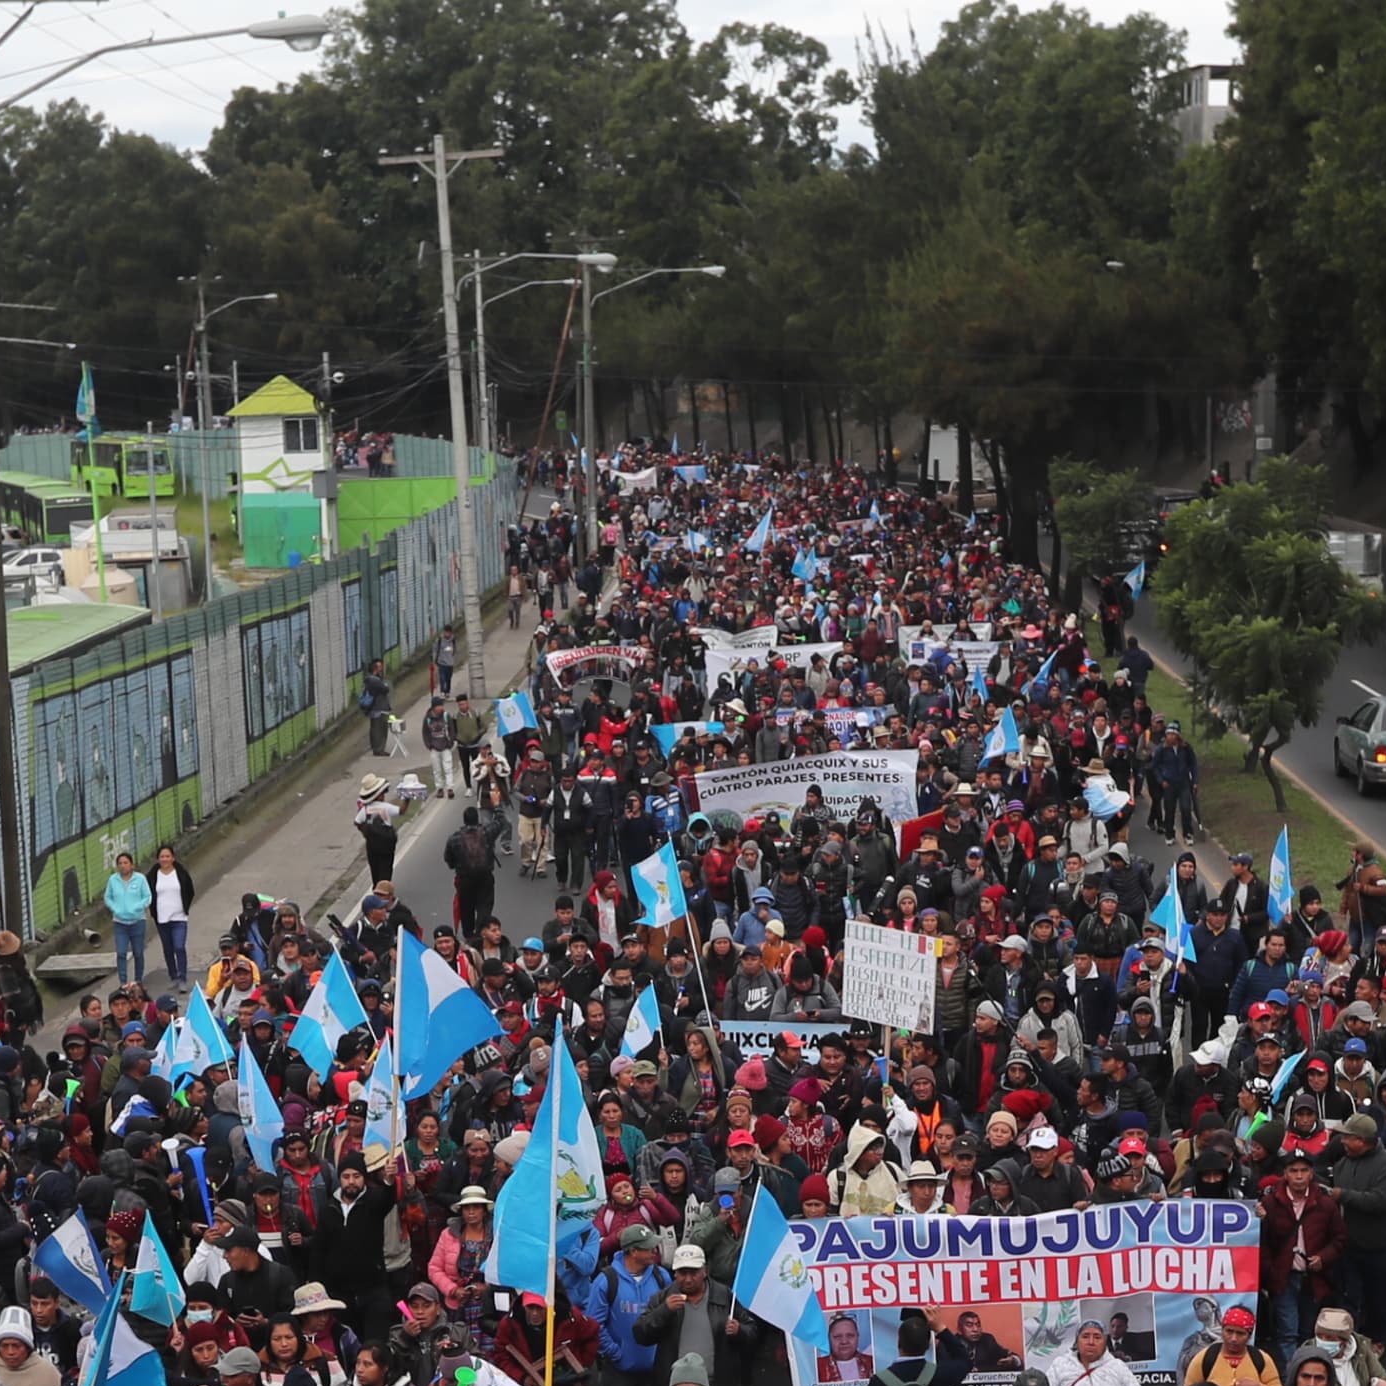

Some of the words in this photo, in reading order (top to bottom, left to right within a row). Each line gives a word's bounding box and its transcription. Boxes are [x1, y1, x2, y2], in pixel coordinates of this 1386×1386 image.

[700, 780, 752, 800] CUATRO
[823, 771, 903, 784] PRESENTES:
[711, 766, 768, 784] CANTÓN
[772, 758, 846, 776] QUIACQUIX
[852, 758, 860, 768] Y
[862, 758, 889, 769] SUS
[790, 1201, 1249, 1263] PAJUMUJUYUP
[809, 1260, 990, 1306] PRESENTE
[1000, 1257, 1046, 1302] EN
[1056, 1254, 1101, 1299] LA
[1111, 1247, 1235, 1294] LUCHA
